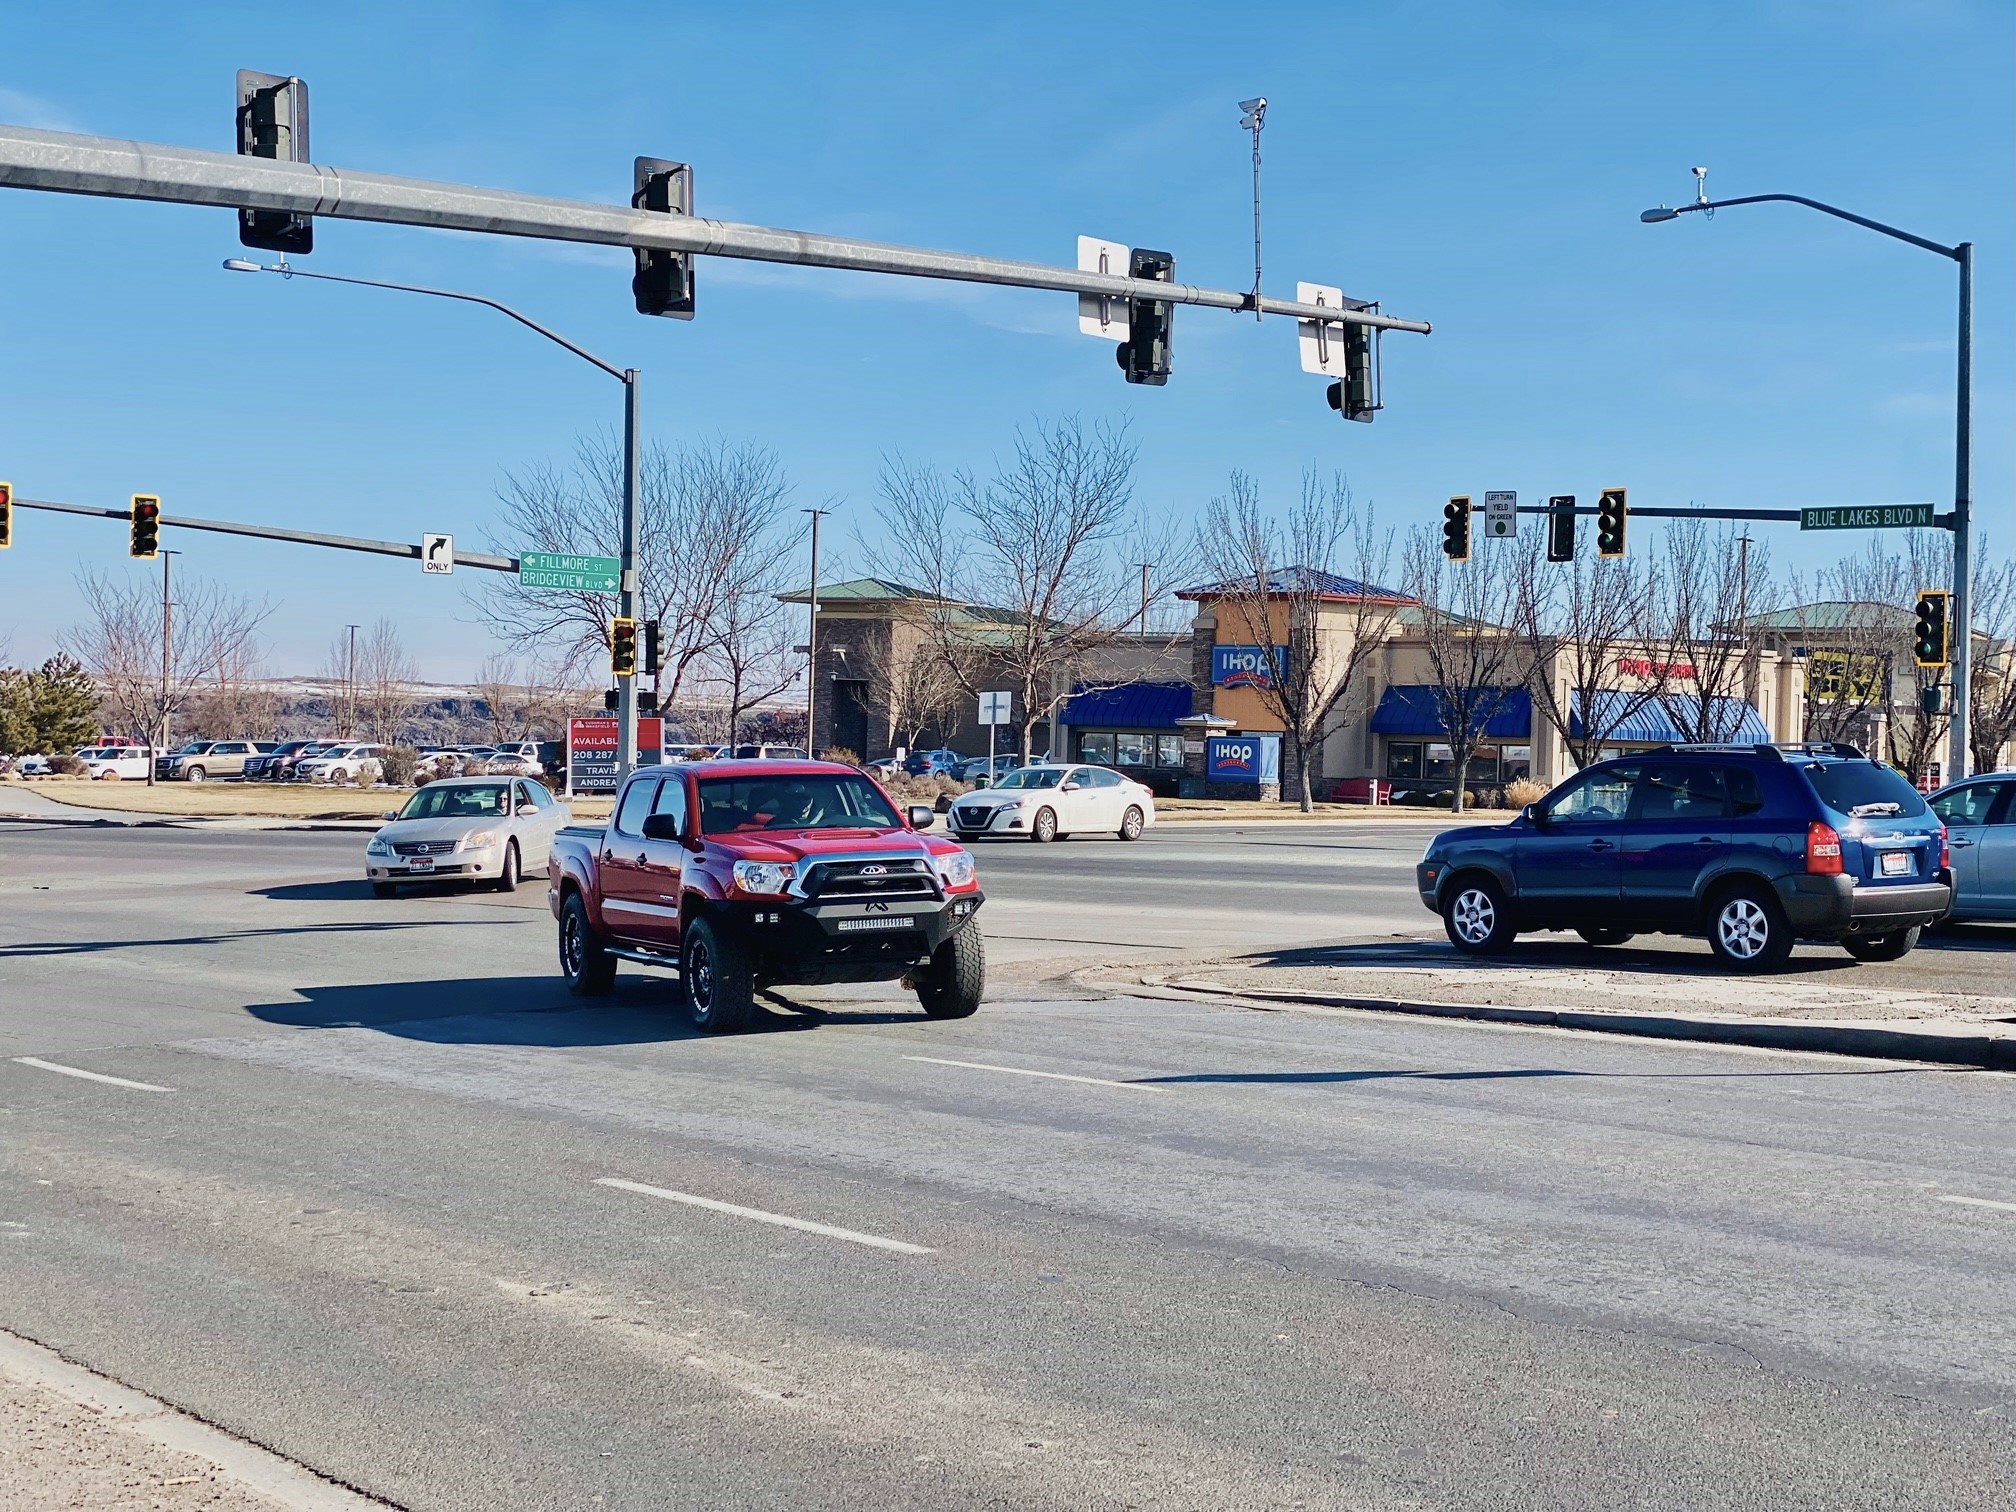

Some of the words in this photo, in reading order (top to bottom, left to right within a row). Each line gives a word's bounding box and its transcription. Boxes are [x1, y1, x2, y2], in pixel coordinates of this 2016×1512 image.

[1492, 503, 1509, 511] YIELD
[1496, 513, 1513, 521] GREEN
[1807, 510, 1837, 527] BLUE
[1840, 509, 1880, 526] LAKES
[1884, 508, 1913, 525] BLVD
[1918, 507, 1927, 524] N
[426, 562, 449, 572] ONLY
[540, 555, 590, 571] FILLMORE
[594, 563, 603, 572] ST
[522, 571, 584, 588] BRIDGEVIEW
[585, 579, 603, 589] BLVD
[573, 737, 618, 745] AVAILABL
[573, 750, 593, 759] 208
[595, 750, 613, 759] 287
